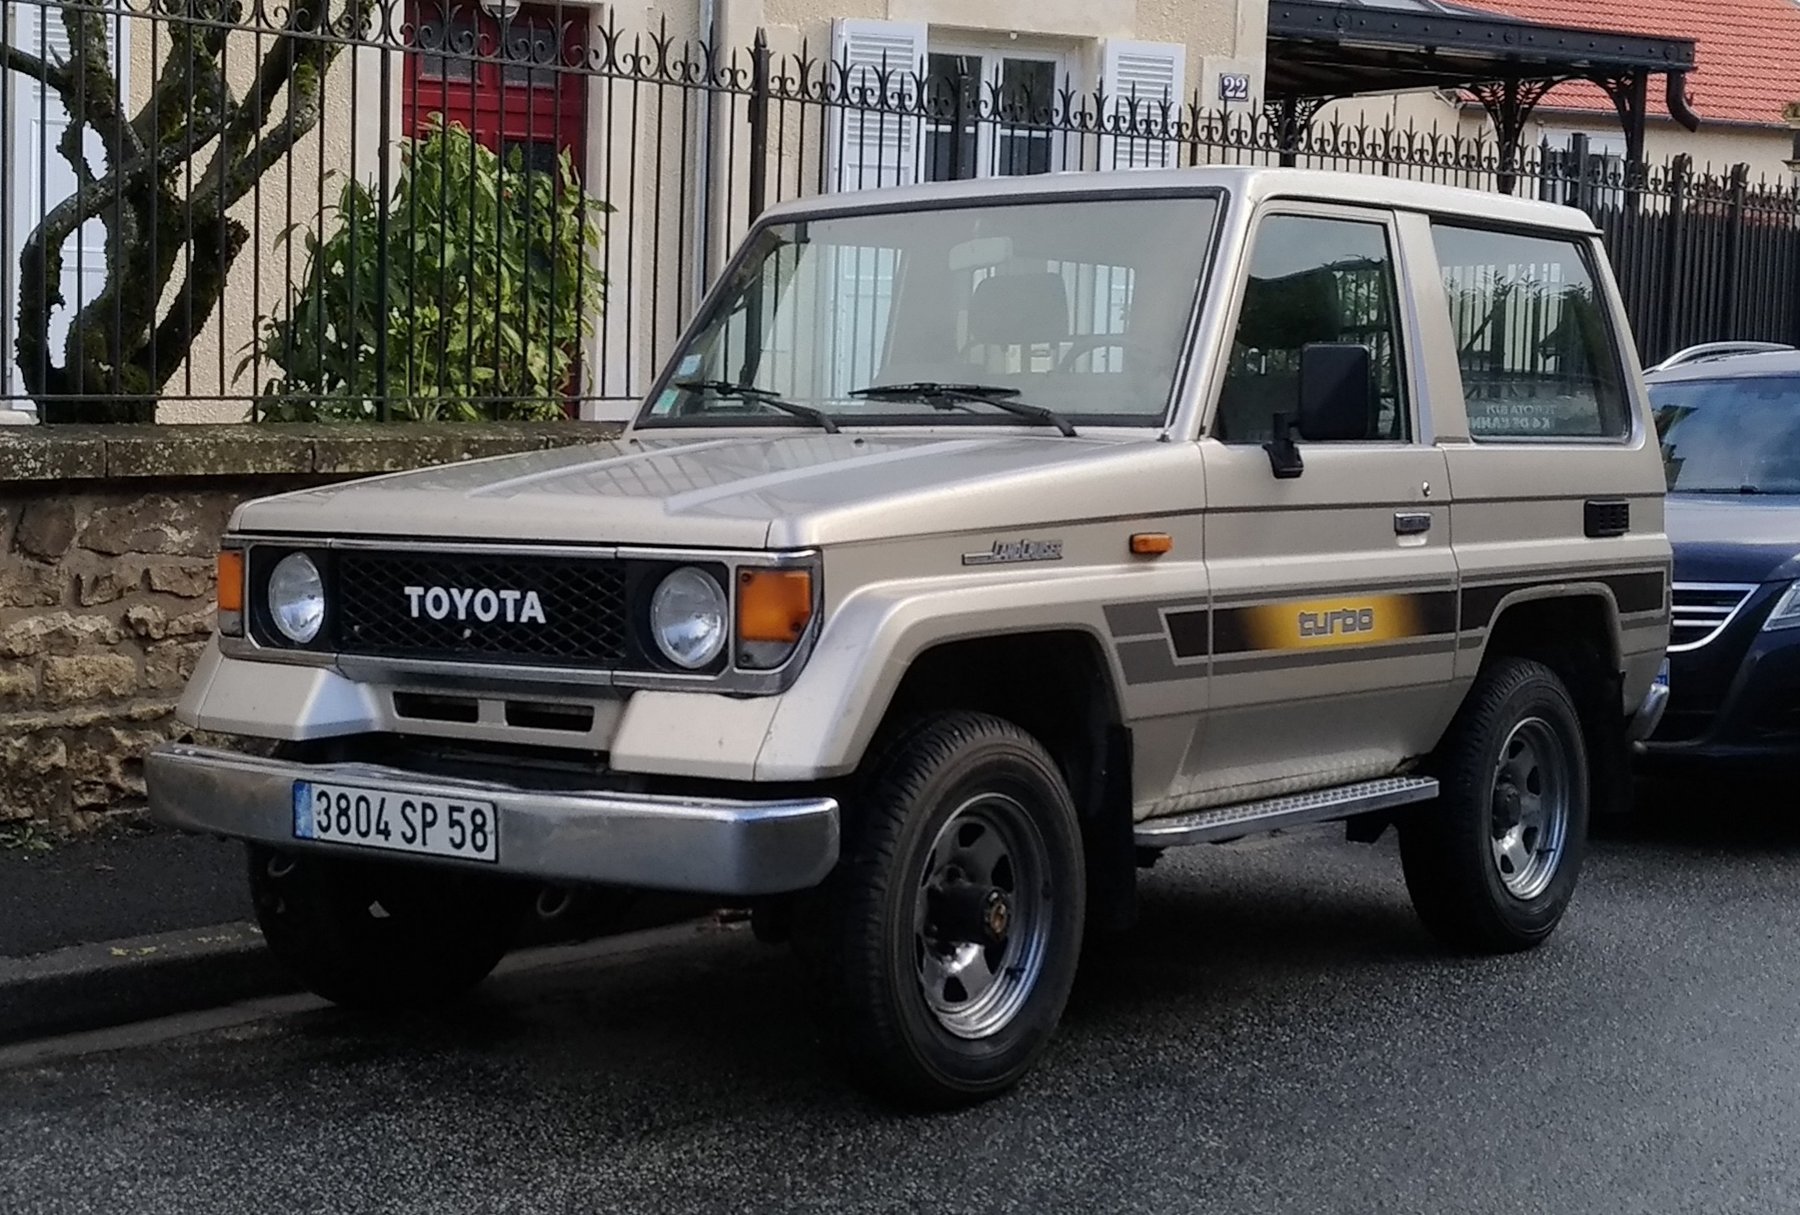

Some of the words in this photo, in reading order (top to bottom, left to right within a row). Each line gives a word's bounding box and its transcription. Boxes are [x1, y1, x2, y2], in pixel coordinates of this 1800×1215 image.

[1223, 76, 1247, 98] 22
[404, 586, 547, 624] TOYOTA
[1298, 608, 1373, 637] turbo
[316, 790, 391, 842] 3804
[401, 800, 438, 846] SP
[449, 805, 488, 852] 58
